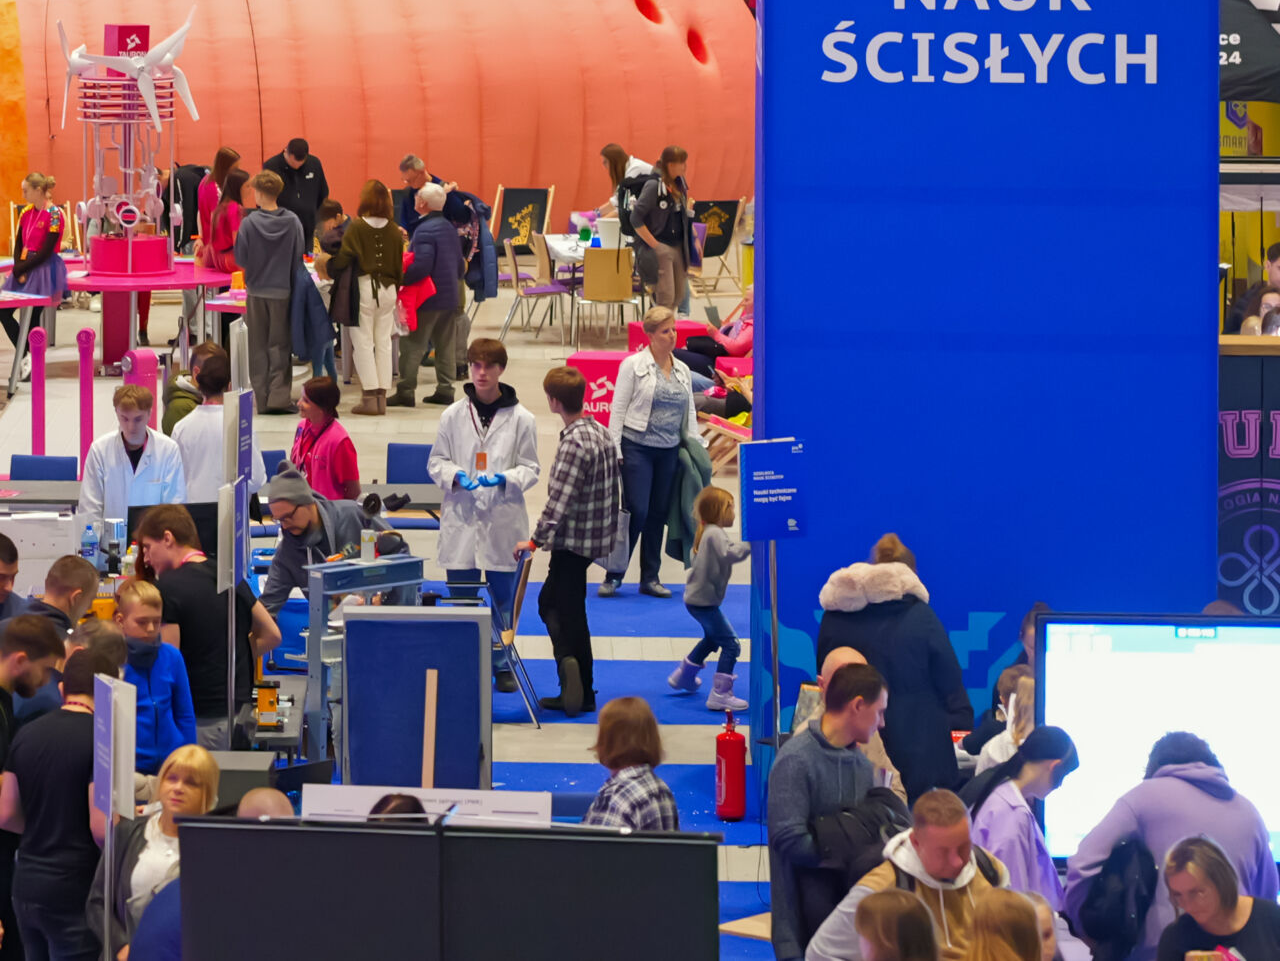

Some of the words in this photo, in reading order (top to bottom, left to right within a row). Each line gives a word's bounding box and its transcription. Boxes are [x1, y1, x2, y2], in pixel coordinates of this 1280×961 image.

[1219, 33, 1241, 45] ce
[821, 20, 1157, 84] ŚCISŁYCH
[1219, 51, 1242, 65] 24
[1219, 135, 1248, 150] MART
[583, 402, 613, 413] AUR
[1224, 492, 1261, 510] OGIA
